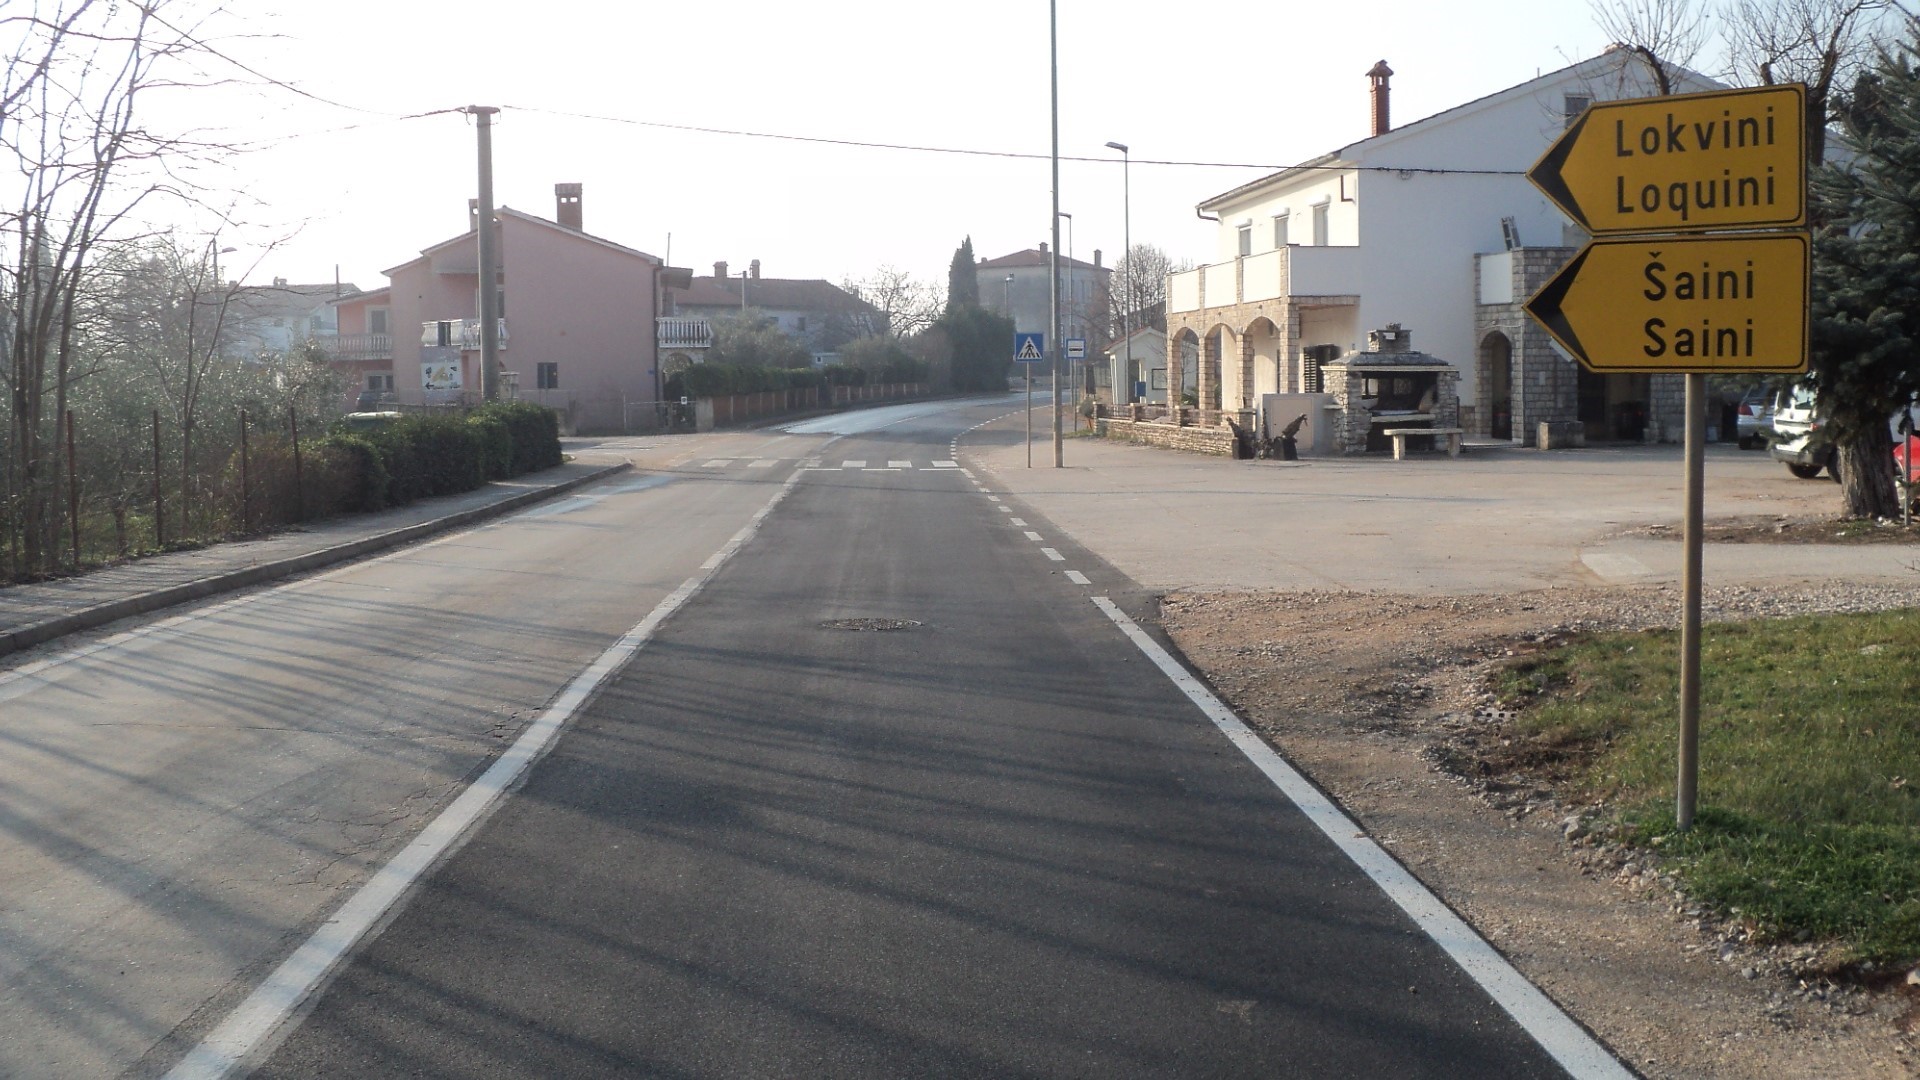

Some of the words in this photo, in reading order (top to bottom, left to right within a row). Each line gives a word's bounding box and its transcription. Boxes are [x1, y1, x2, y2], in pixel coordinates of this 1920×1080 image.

[1616, 106, 1775, 157] Lokvini
[1616, 166, 1775, 221] Loquini
[1643, 251, 1754, 302] Šaini
[1643, 317, 1754, 358] Saini
